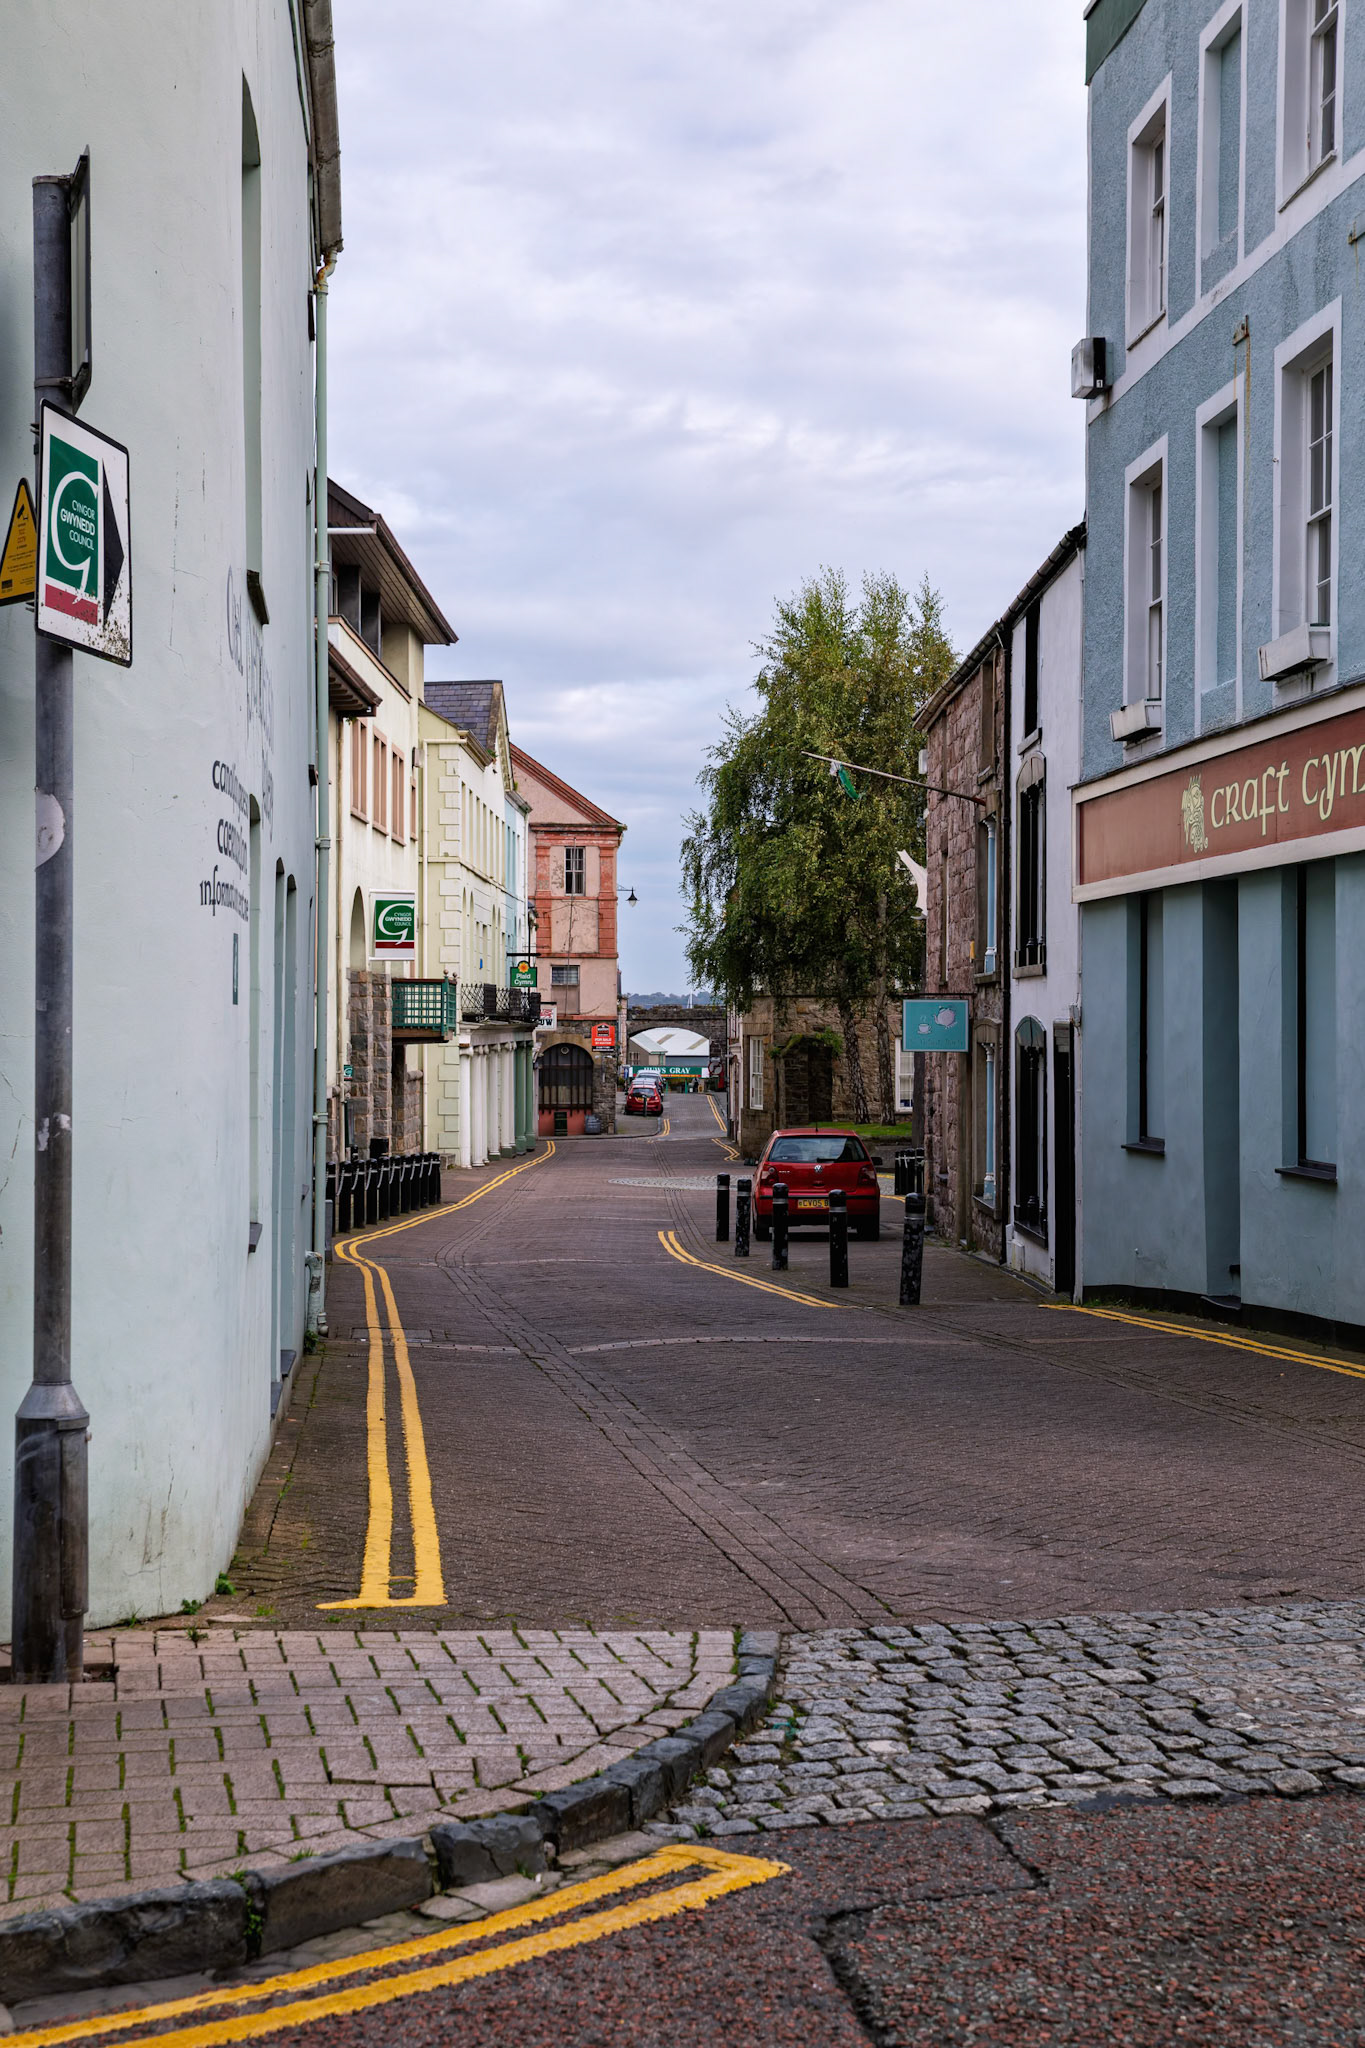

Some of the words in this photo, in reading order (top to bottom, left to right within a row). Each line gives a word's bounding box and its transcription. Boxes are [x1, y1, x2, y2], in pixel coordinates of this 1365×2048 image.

[72, 499, 96, 520] CYNGOR
[60, 508, 95, 536] GWYNEDD
[69, 529, 95, 551] COUNCIL
[669, 1066, 691, 1074] GRAY
